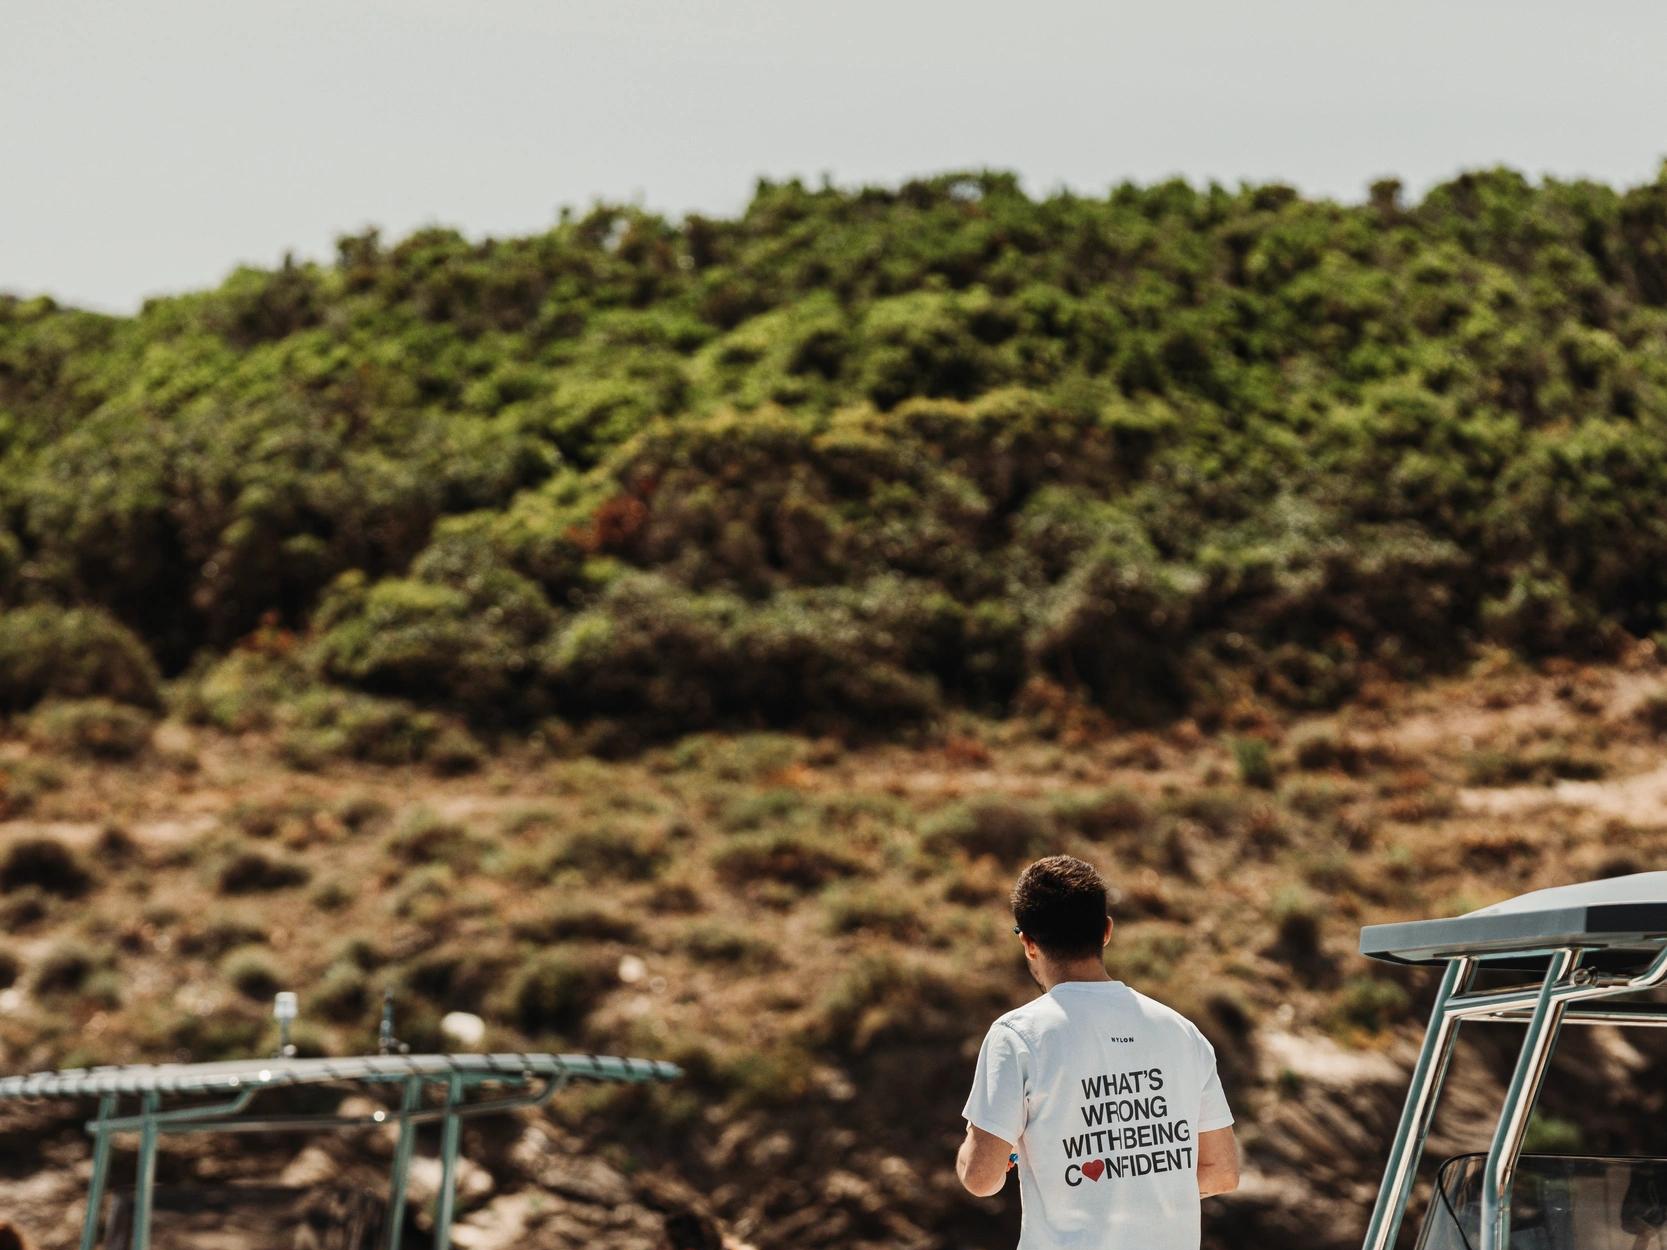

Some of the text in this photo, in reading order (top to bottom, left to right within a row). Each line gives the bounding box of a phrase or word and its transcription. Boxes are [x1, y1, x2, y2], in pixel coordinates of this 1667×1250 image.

[1081, 1068, 1163, 1100] WHAT'S
[1081, 1096, 1168, 1127] WRONG
[1064, 1147, 1192, 1187] CNFIDENT
